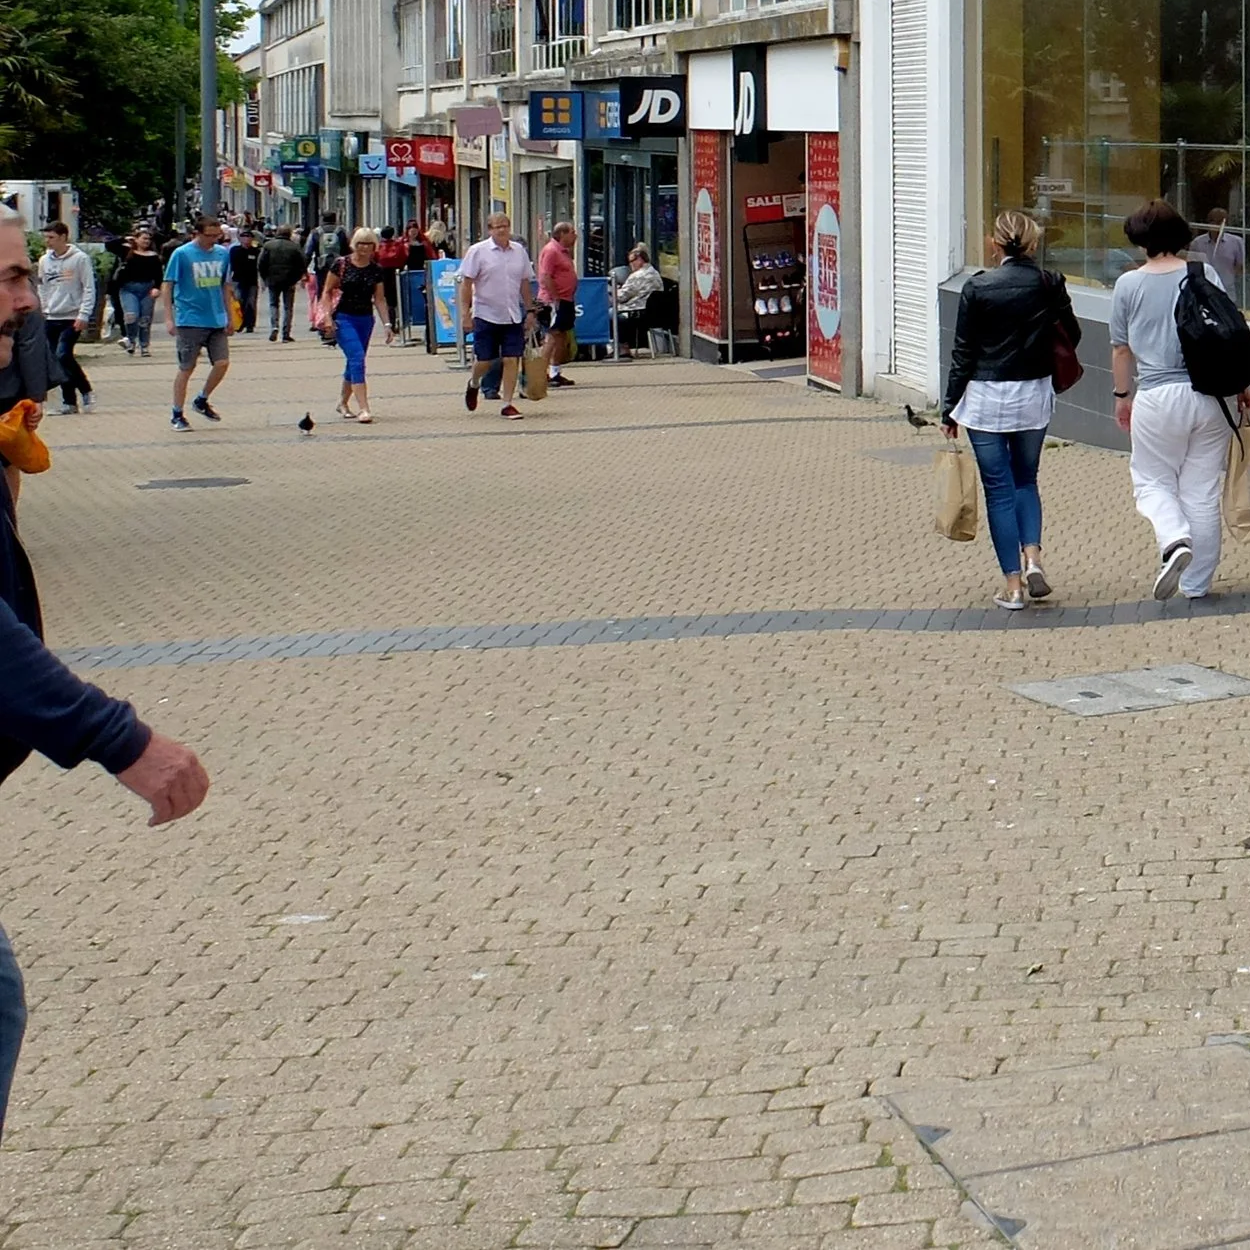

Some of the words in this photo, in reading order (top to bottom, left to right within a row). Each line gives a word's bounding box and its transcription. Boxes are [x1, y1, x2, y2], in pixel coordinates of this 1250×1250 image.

[627, 88, 681, 125] JD
[734, 71, 756, 137] JD
[746, 194, 782, 208] SALE
[697, 242, 712, 264] SALE
[817, 246, 838, 271] EVER
[817, 269, 838, 296] SALE
